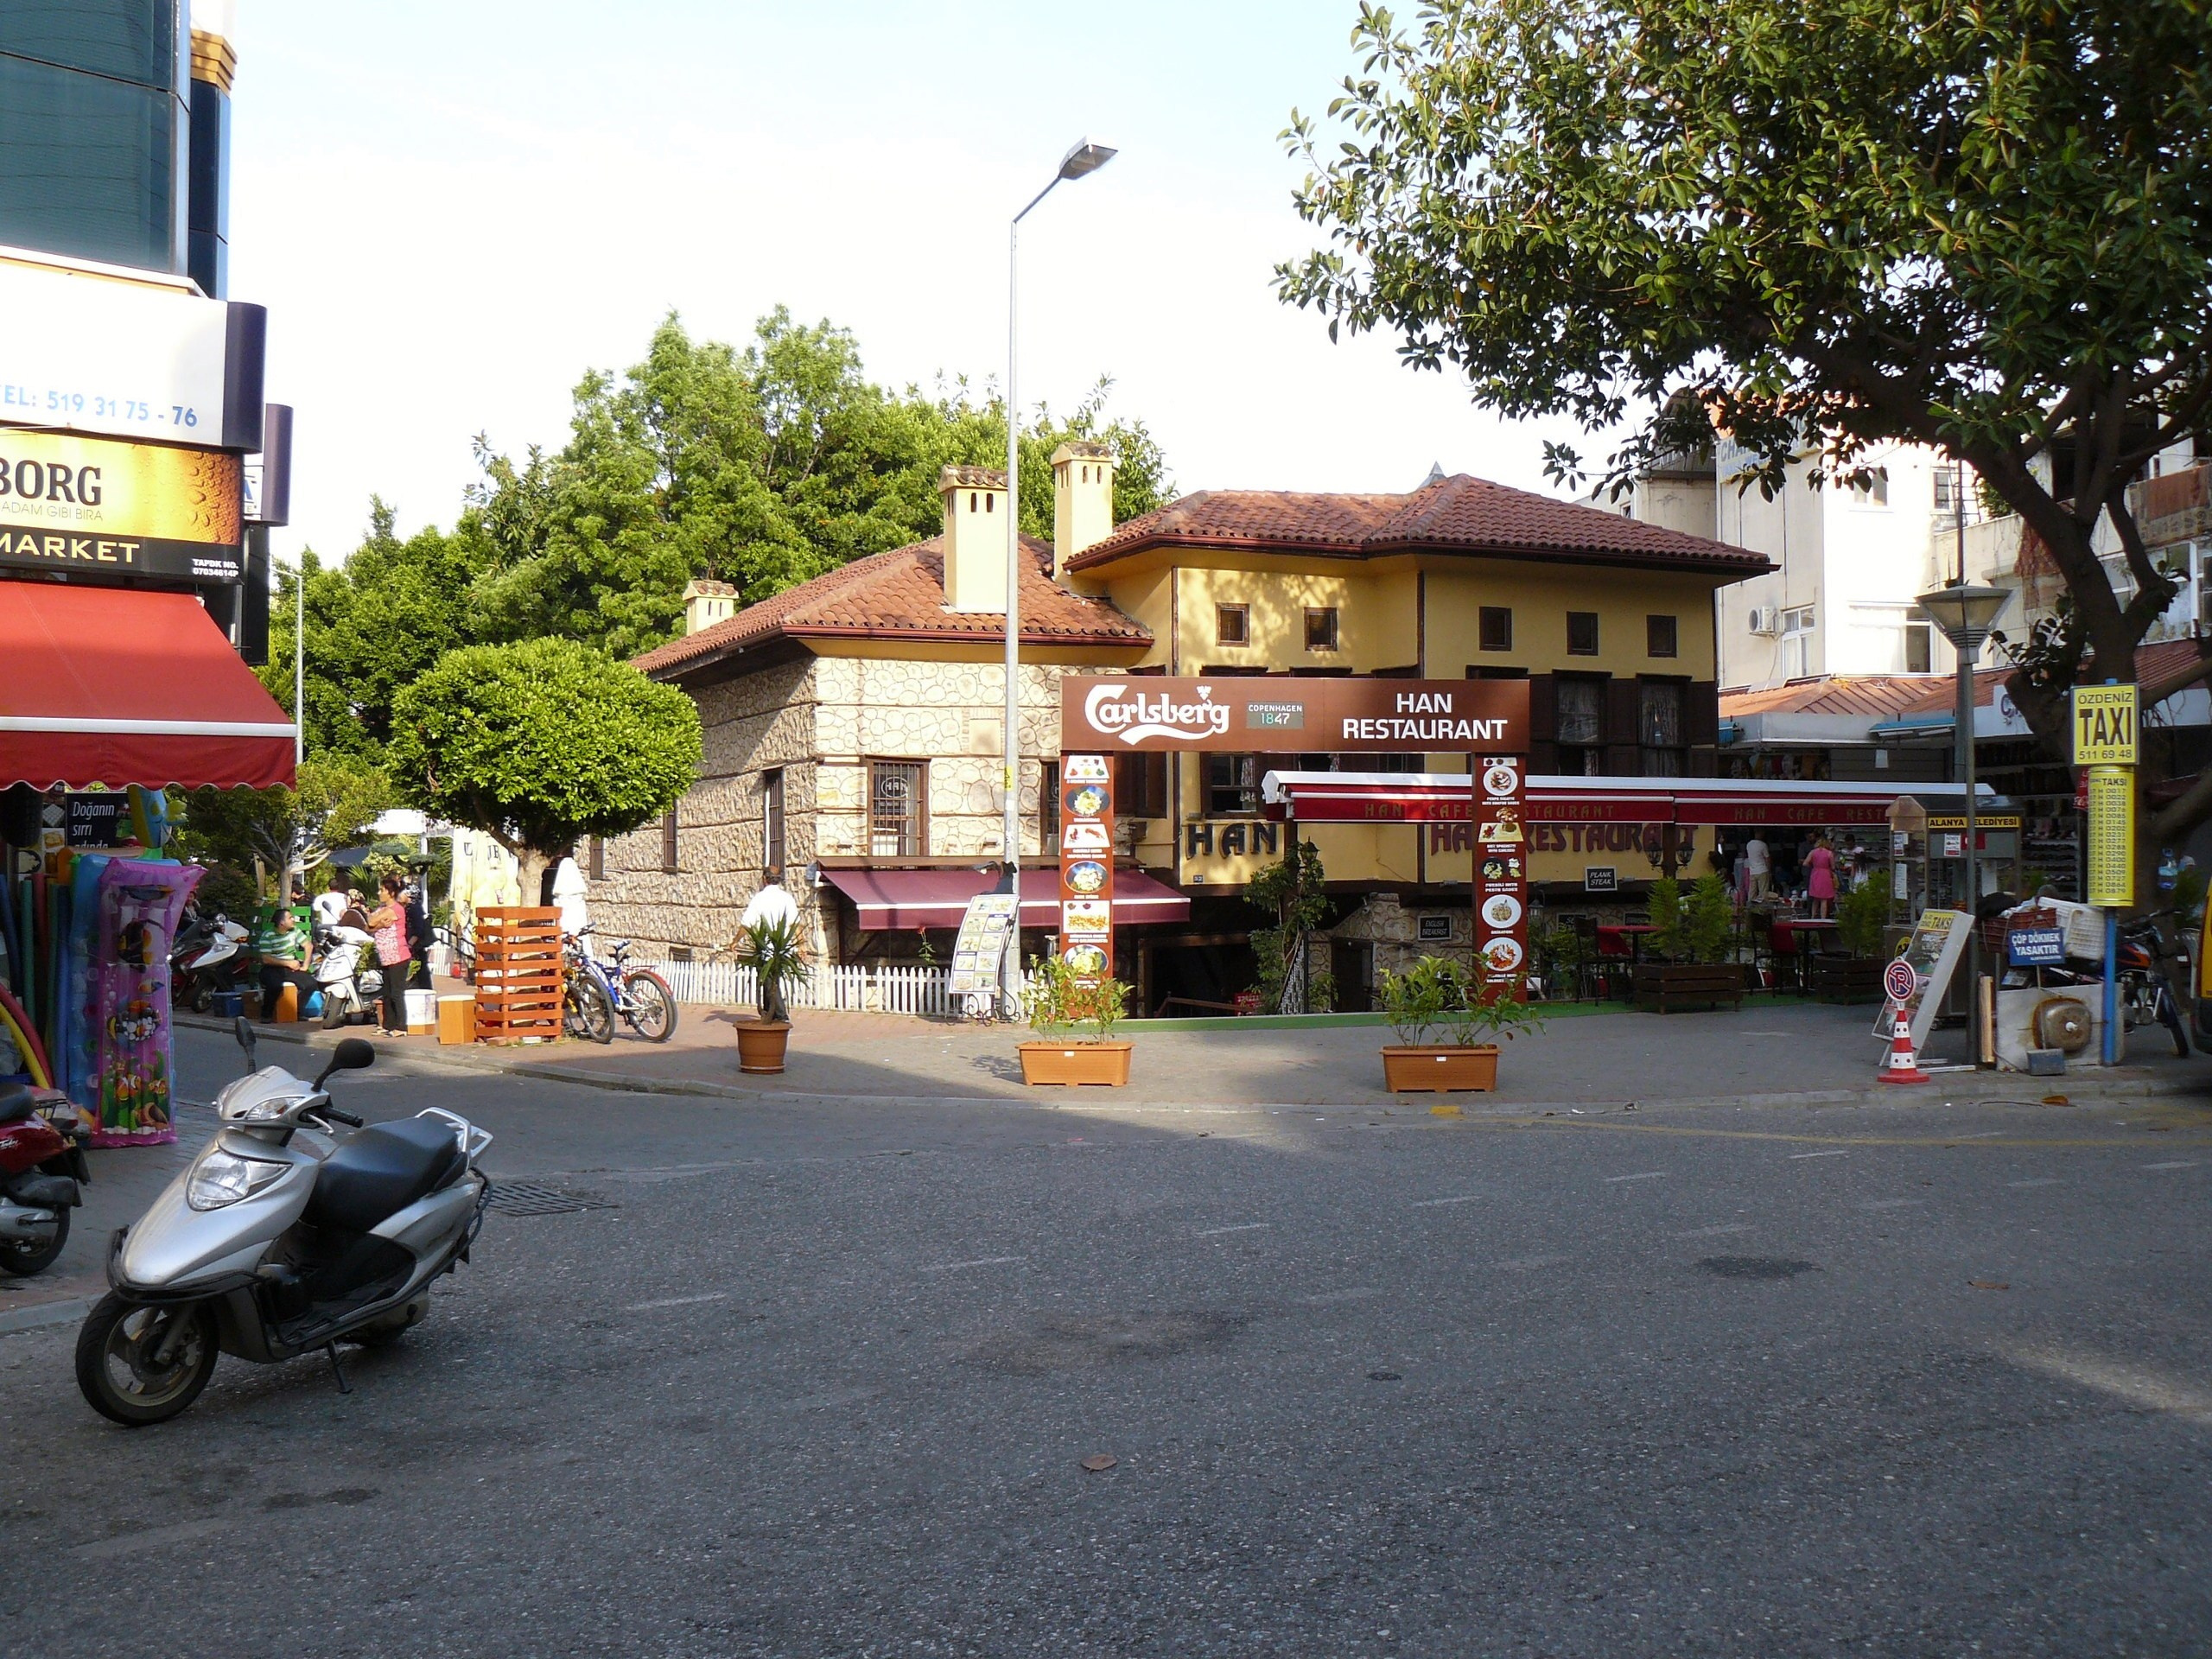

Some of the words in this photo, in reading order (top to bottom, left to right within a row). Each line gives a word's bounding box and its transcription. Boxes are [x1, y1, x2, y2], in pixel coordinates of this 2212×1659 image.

[0, 385, 36, 407] EL:
[47, 391, 84, 412] 519
[94, 397, 117, 417] 31
[125, 400, 149, 421] 75
[172, 406, 198, 427] 76
[2, 500, 42, 516] ADAM
[1396, 693, 1452, 713] HAN
[2078, 691, 2133, 704] ÖZDENİZ
[1084, 684, 1230, 736] Carlsberg
[1248, 704, 1303, 713] COPENHAGEN
[1261, 713, 1290, 725] 1847
[2079, 706, 2132, 747] TAXI
[1343, 718, 1508, 740] RESTAURANT
[2079, 750, 2097, 760] 511
[2101, 749, 2114, 759] 69
[2119, 749, 2132, 758] 48
[73, 802, 115, 820] Doğanın
[1364, 803, 1402, 818] HAN
[1427, 804, 1472, 818] CAFE
[1788, 808, 1825, 820] CAFE
[1929, 818, 1964, 827] ALANYA
[1974, 817, 2017, 826] ELEDİYESİ
[1185, 823, 1277, 861] HAN
[1431, 823, 1471, 856] HA
[2012, 932, 2027, 946] ÇÖP
[2028, 931, 2060, 944] DÖKMEK
[2015, 944, 2059, 956] YASAKTIR
